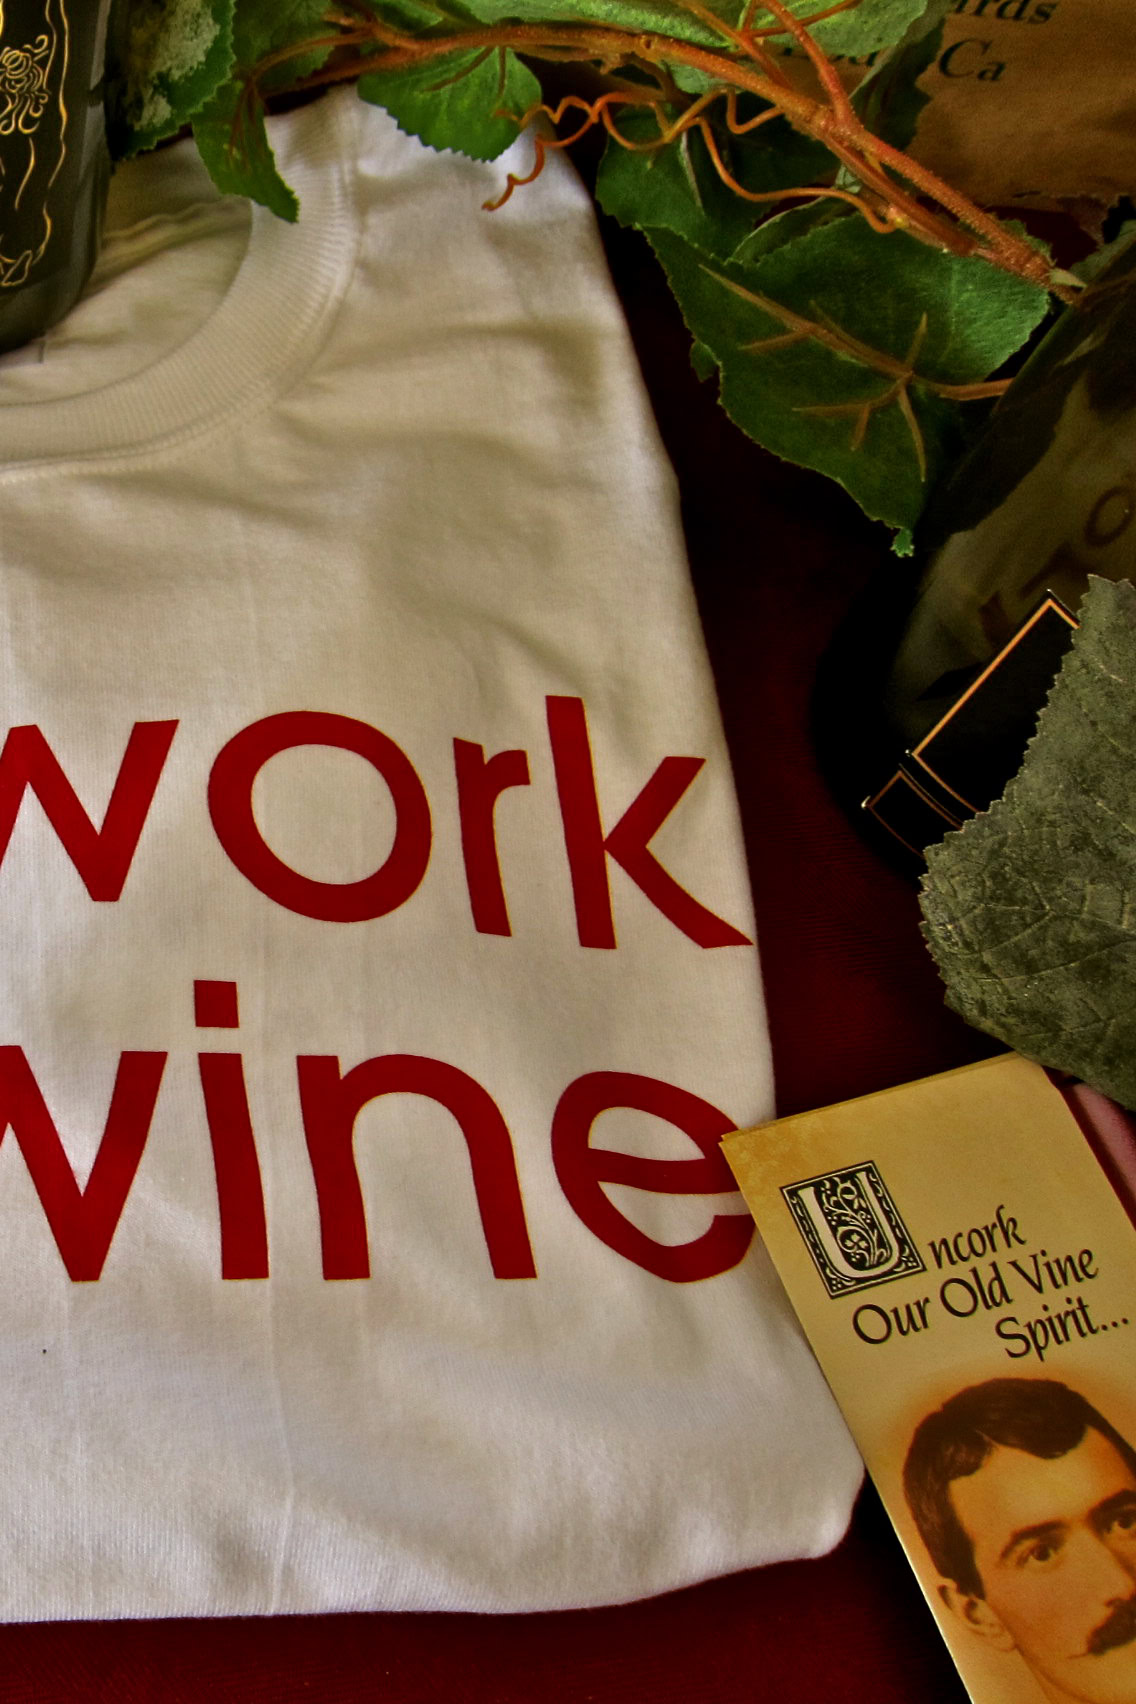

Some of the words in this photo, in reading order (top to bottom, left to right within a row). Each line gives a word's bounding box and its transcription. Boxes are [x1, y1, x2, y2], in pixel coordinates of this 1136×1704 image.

[851, 1296, 932, 1345] Our
[939, 1261, 1013, 1318] Old
[1007, 1248, 1100, 1296] Vine
